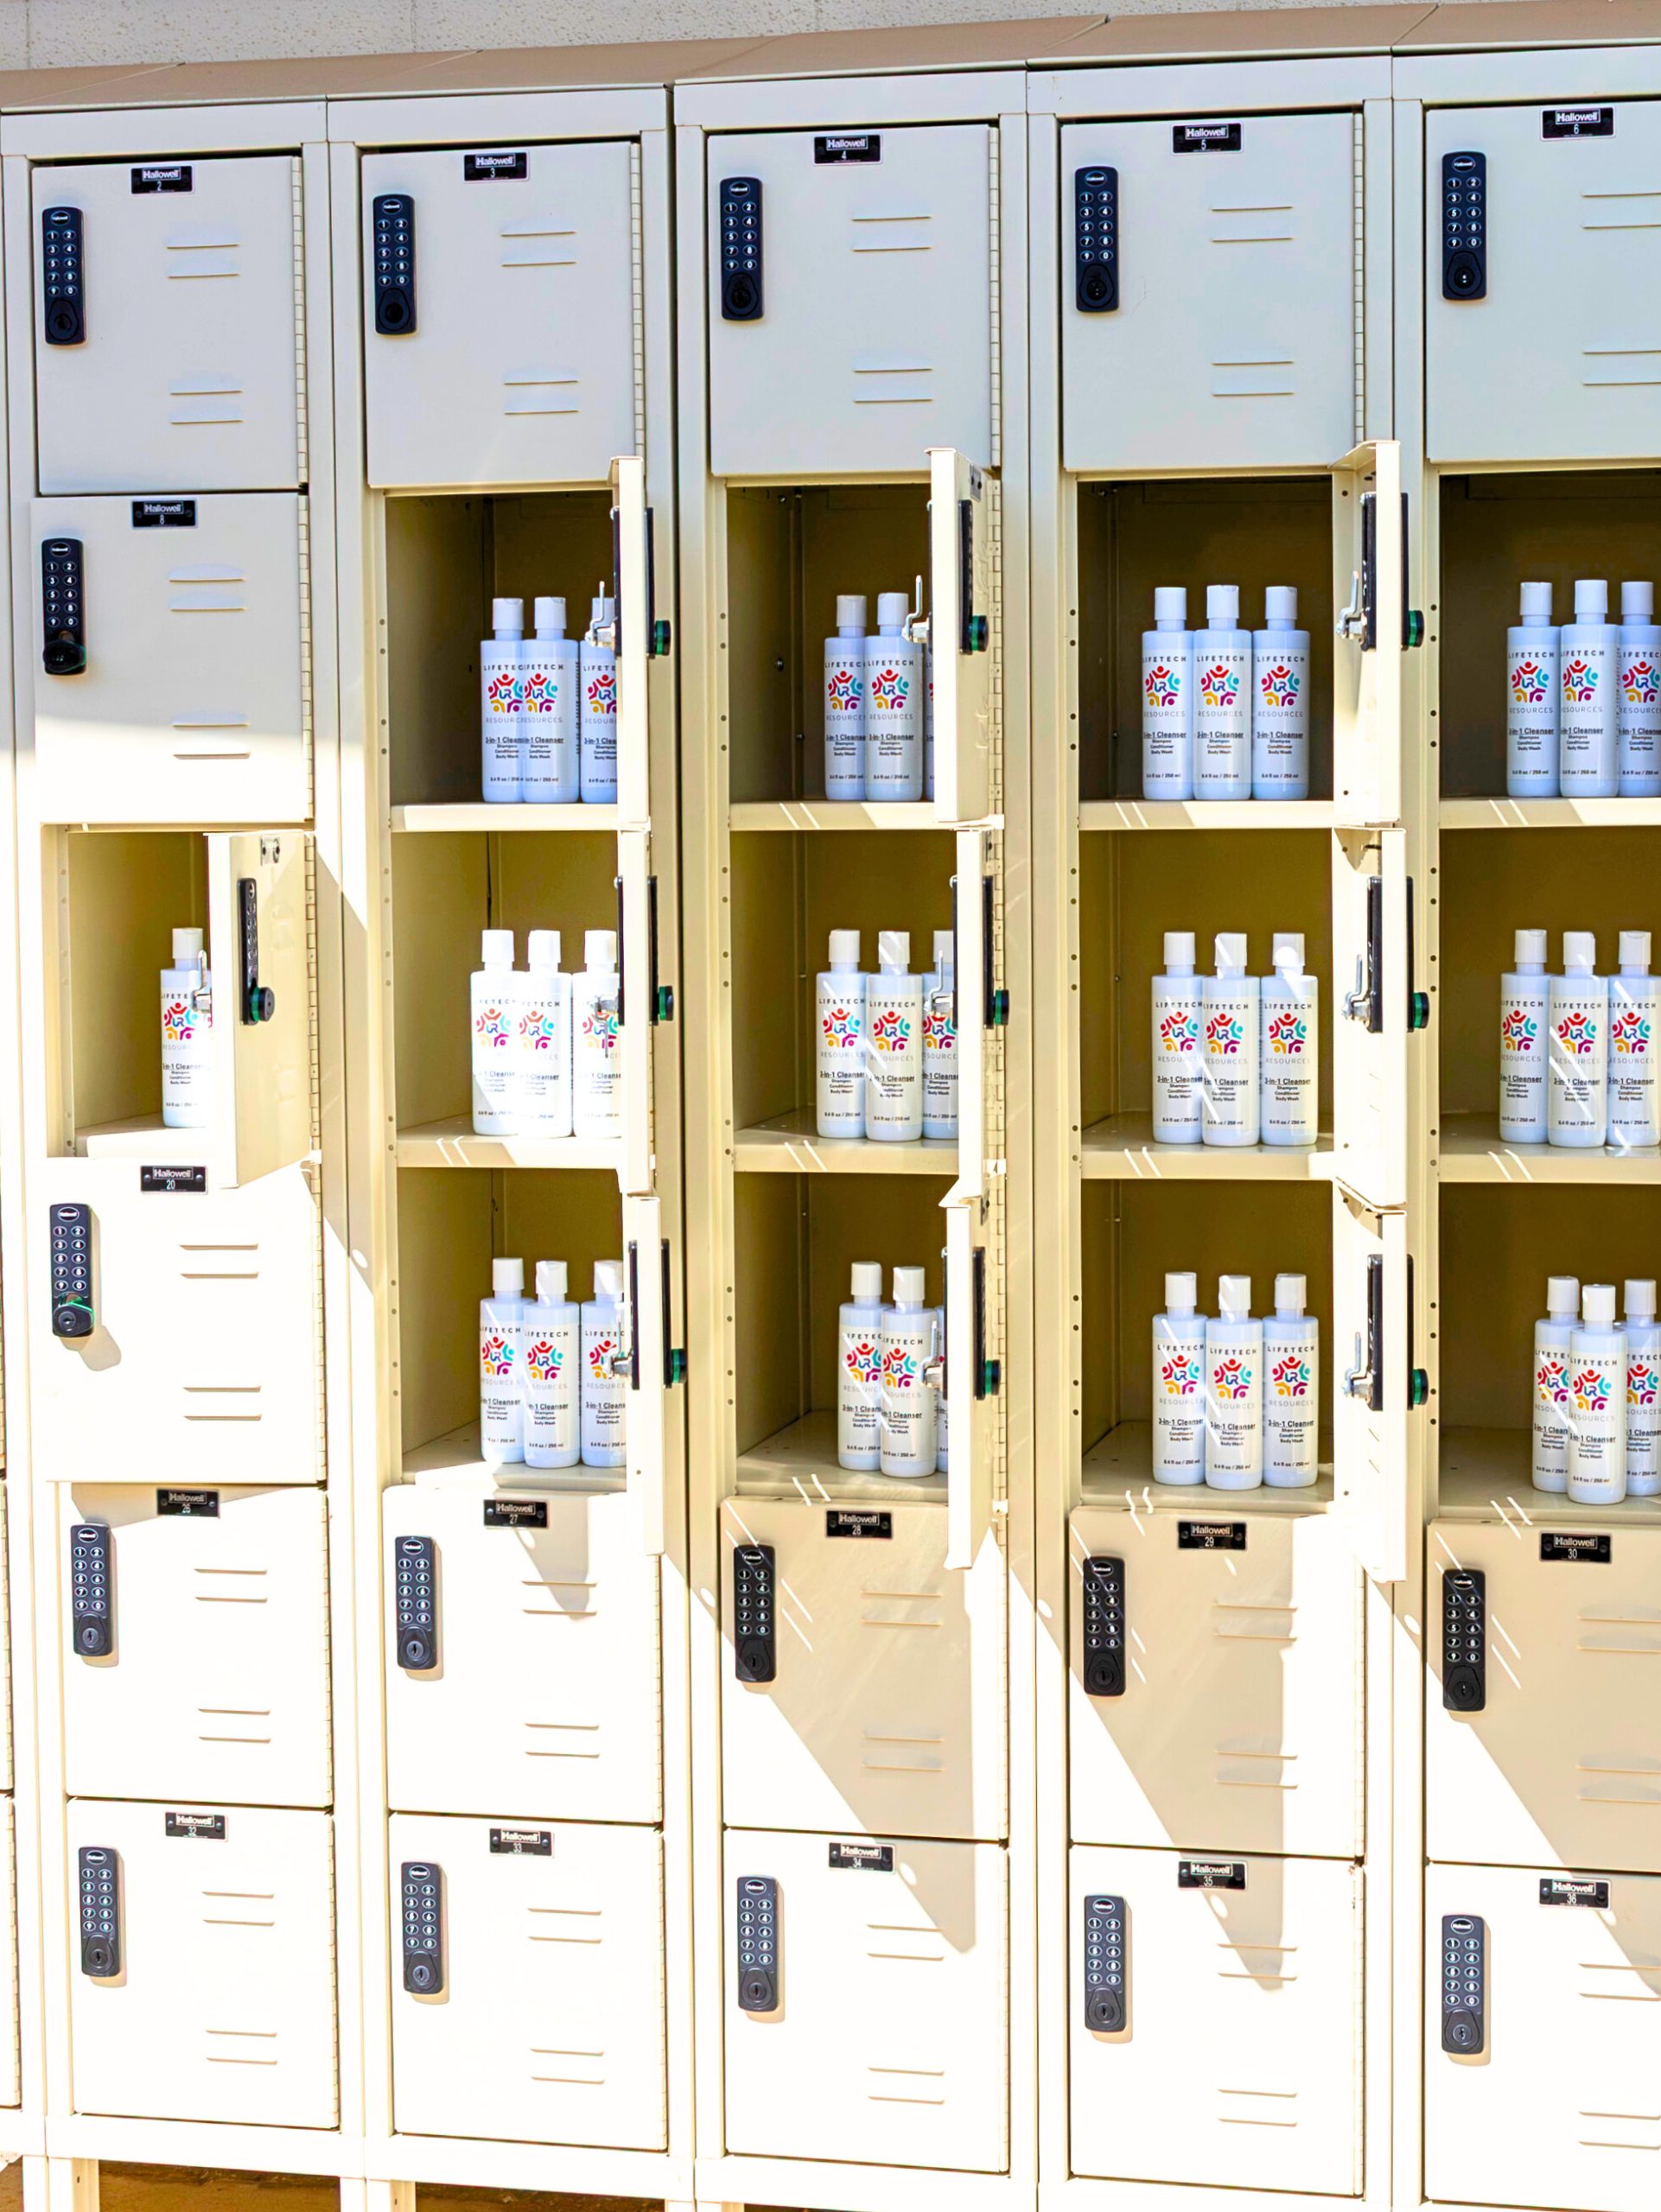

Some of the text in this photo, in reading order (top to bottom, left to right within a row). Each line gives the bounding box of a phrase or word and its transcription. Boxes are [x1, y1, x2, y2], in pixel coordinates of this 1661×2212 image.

[1556, 111, 1598, 123] Hallowell
[1187, 127, 1226, 137] Hallowell
[1573, 124, 1579, 134] 6
[827, 139, 866, 149] Hallowell
[1201, 140, 1206, 149] 5
[842, 150, 847, 160] 4
[476, 156, 514, 166] Hallowell
[143, 169, 180, 180] Hallowell
[490, 168, 495, 177] 3
[157, 181, 162, 191] 2
[144, 504, 181, 513] Hallowell
[159, 515, 164, 524] 8
[154, 1168, 191, 1179] Hallowell
[167, 1179, 175, 1189] 20
[1569, 1357, 1618, 1366] LIFETECH
[169, 1492, 205, 1503] Hallowell
[497, 1503, 534, 1514] Hallowell
[509, 1515, 518, 1524] 27
[840, 1514, 877, 1523] Hallowell
[852, 1525, 862, 1535] 28
[1192, 1525, 1231, 1535] Hallowell
[1205, 1536, 1214, 1547] 29
[1555, 1536, 1595, 1548] Hallowell
[1568, 1548, 1577, 1559] 30
[176, 1814, 213, 1827] Hallowell
[188, 1827, 196, 1836] 32
[502, 1831, 538, 1842] Hallowell
[513, 1843, 522, 1853] 33
[842, 1845, 880, 1857] Hallowell
[853, 1858, 862, 1867] 34
[1192, 1863, 1231, 1874] Hallowell
[1204, 1876, 1212, 1886] 35
[1554, 1881, 1594, 1892] Hallowell
[1567, 1893, 1576, 1904] 36
